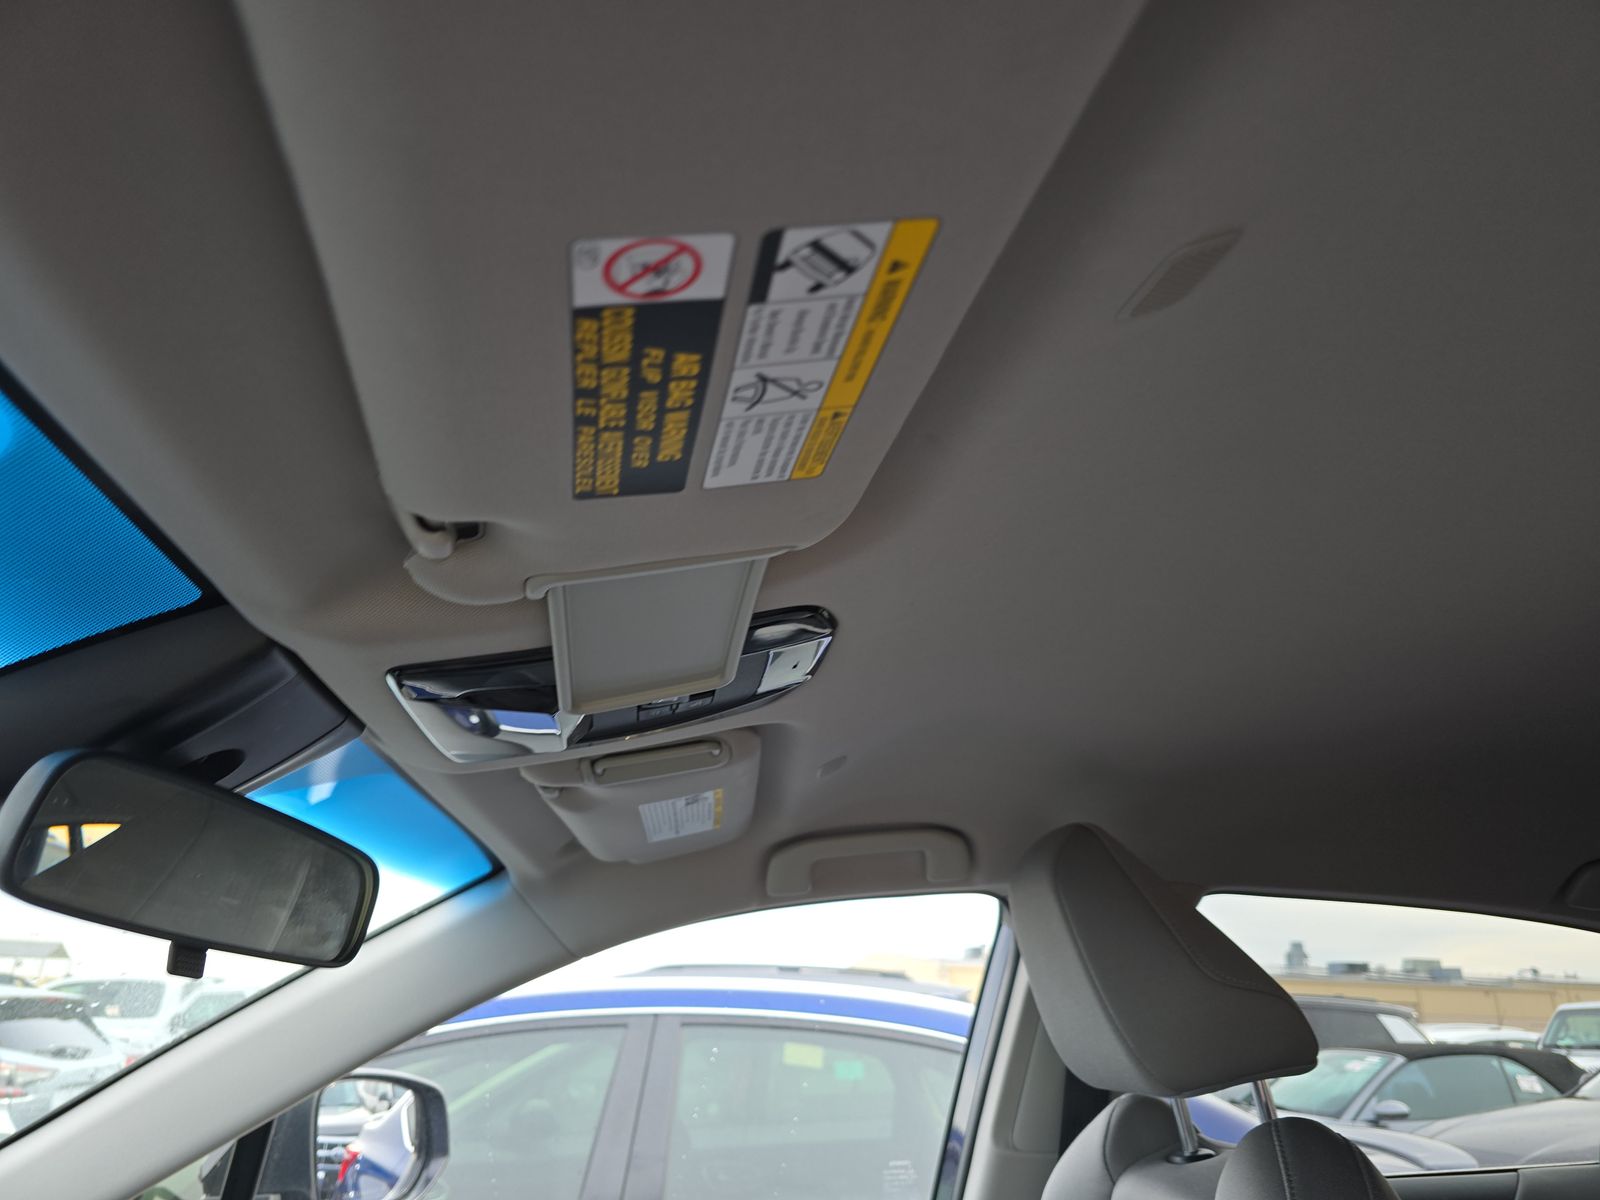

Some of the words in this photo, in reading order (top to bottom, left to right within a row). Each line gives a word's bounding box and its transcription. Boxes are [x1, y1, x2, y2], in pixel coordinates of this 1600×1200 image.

[641, 347, 665, 384] FLIP
[576, 398, 597, 418] LE
[635, 390, 659, 431] VISOR
[665, 380, 697, 408] BAG
[632, 436, 653, 468] OVER
[656, 411, 690, 462] WARNING
